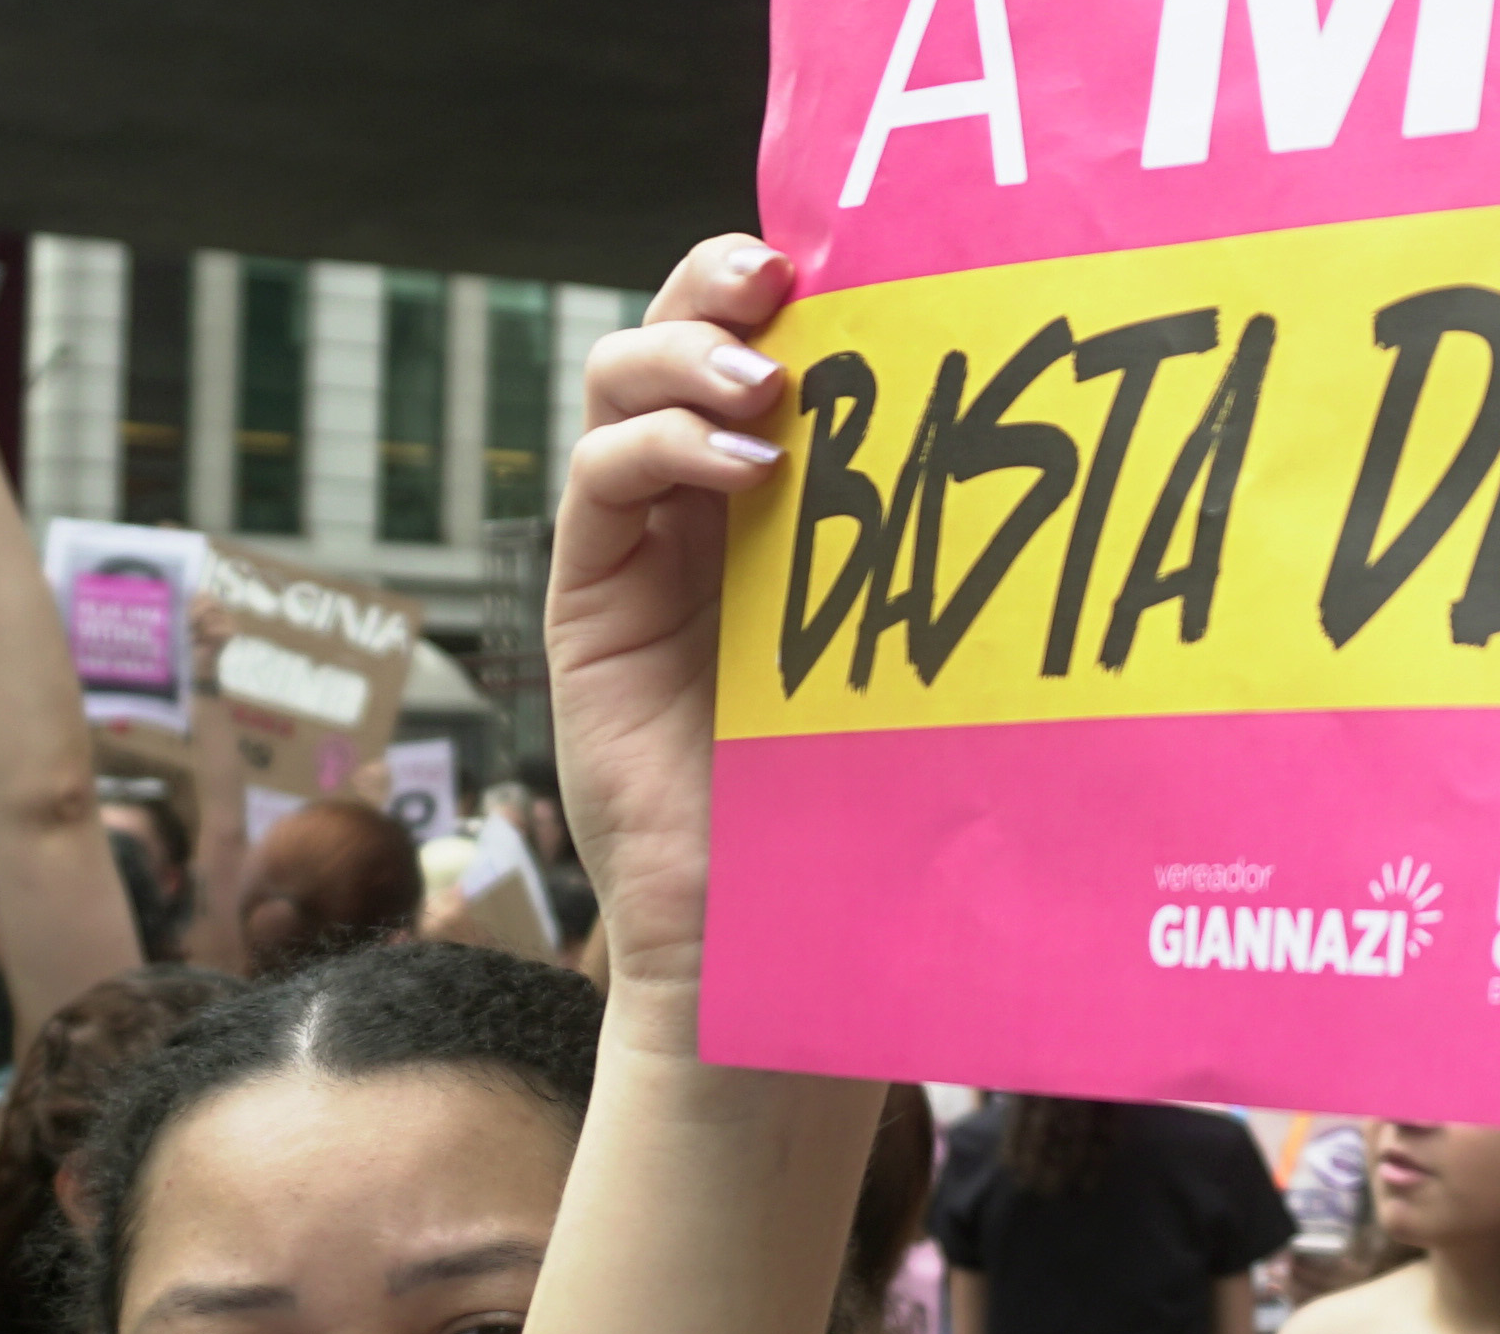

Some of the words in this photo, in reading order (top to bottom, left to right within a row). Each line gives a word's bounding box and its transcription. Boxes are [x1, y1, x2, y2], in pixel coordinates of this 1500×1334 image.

[777, 312, 1273, 698] BASTA
[1153, 855, 1276, 894] vereador
[1149, 904, 1408, 978] GIANNAZI
